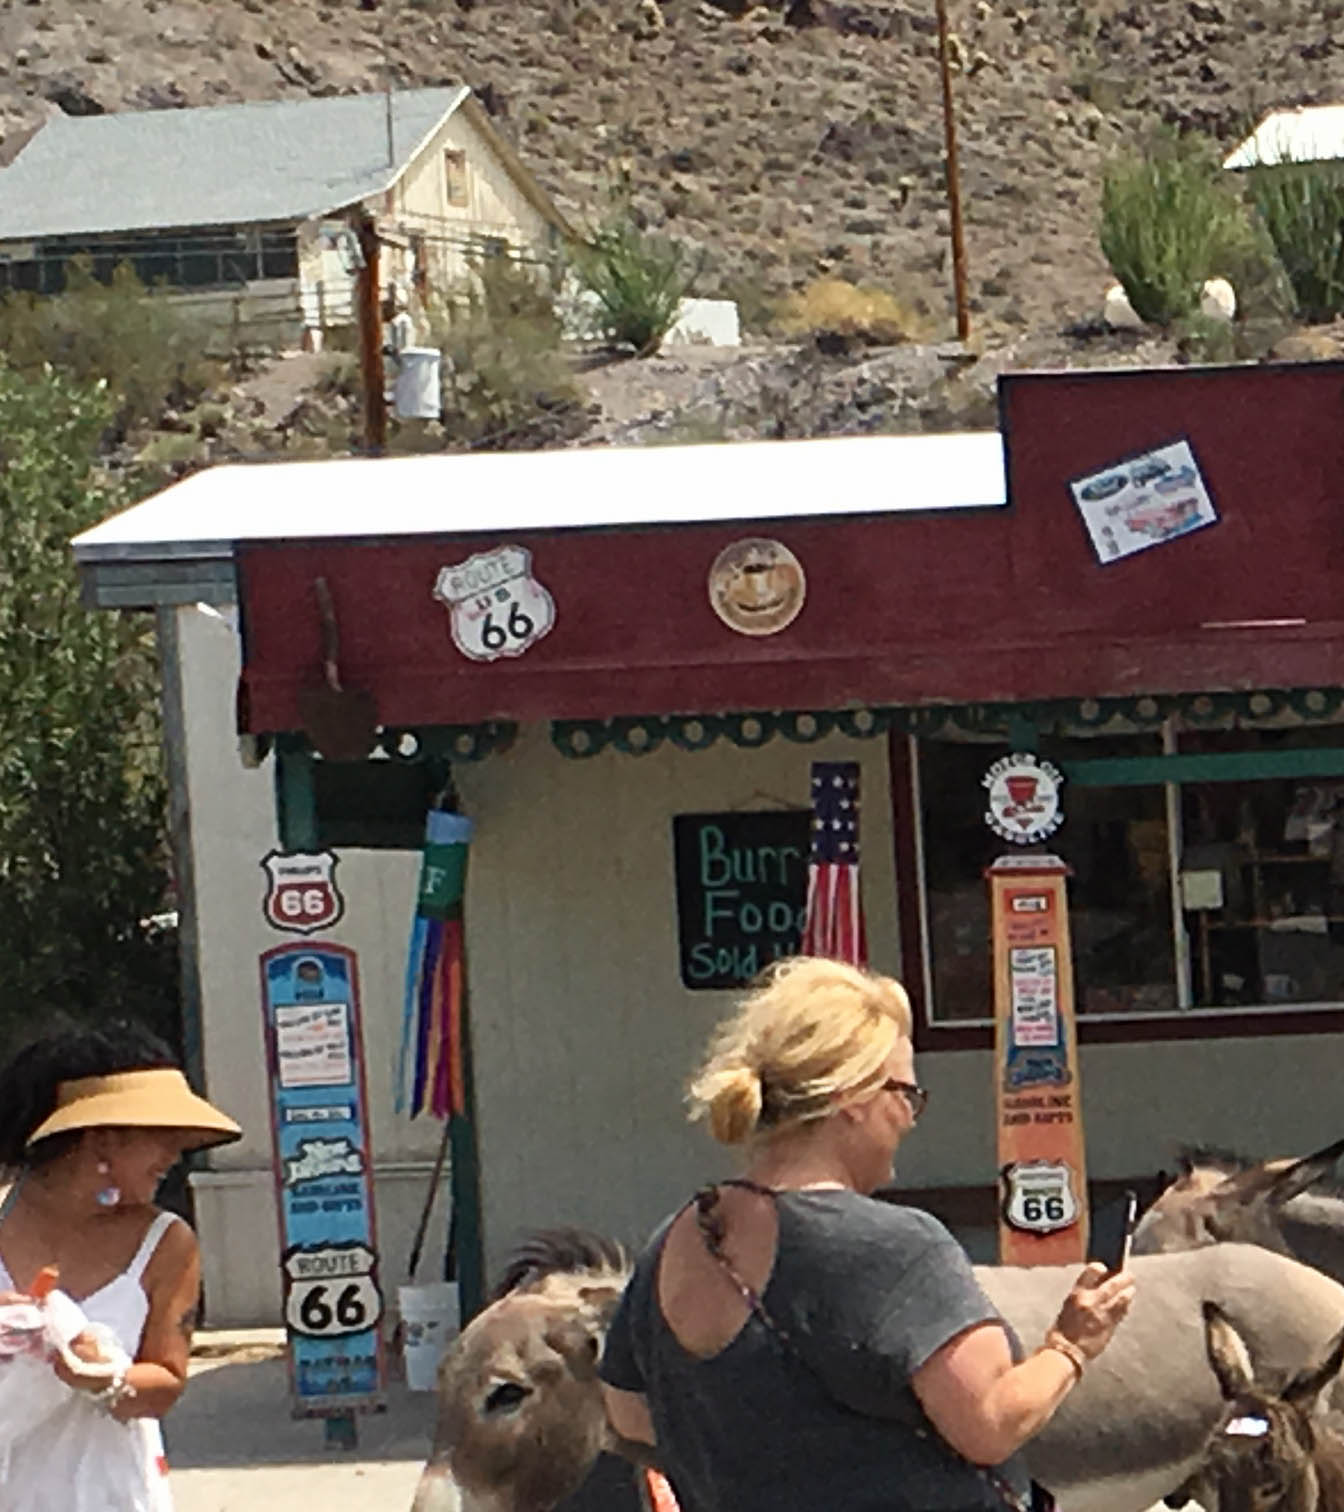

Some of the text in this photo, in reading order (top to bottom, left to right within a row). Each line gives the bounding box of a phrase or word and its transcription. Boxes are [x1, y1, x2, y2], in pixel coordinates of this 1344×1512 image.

[449, 554, 515, 594] ROUTE
[482, 602, 534, 649] 66
[700, 825, 808, 887] Burr
[280, 888, 325, 917] 66
[1024, 1197, 1065, 1222] 66
[296, 1253, 360, 1275] ROUTE
[300, 1283, 366, 1331] 66
